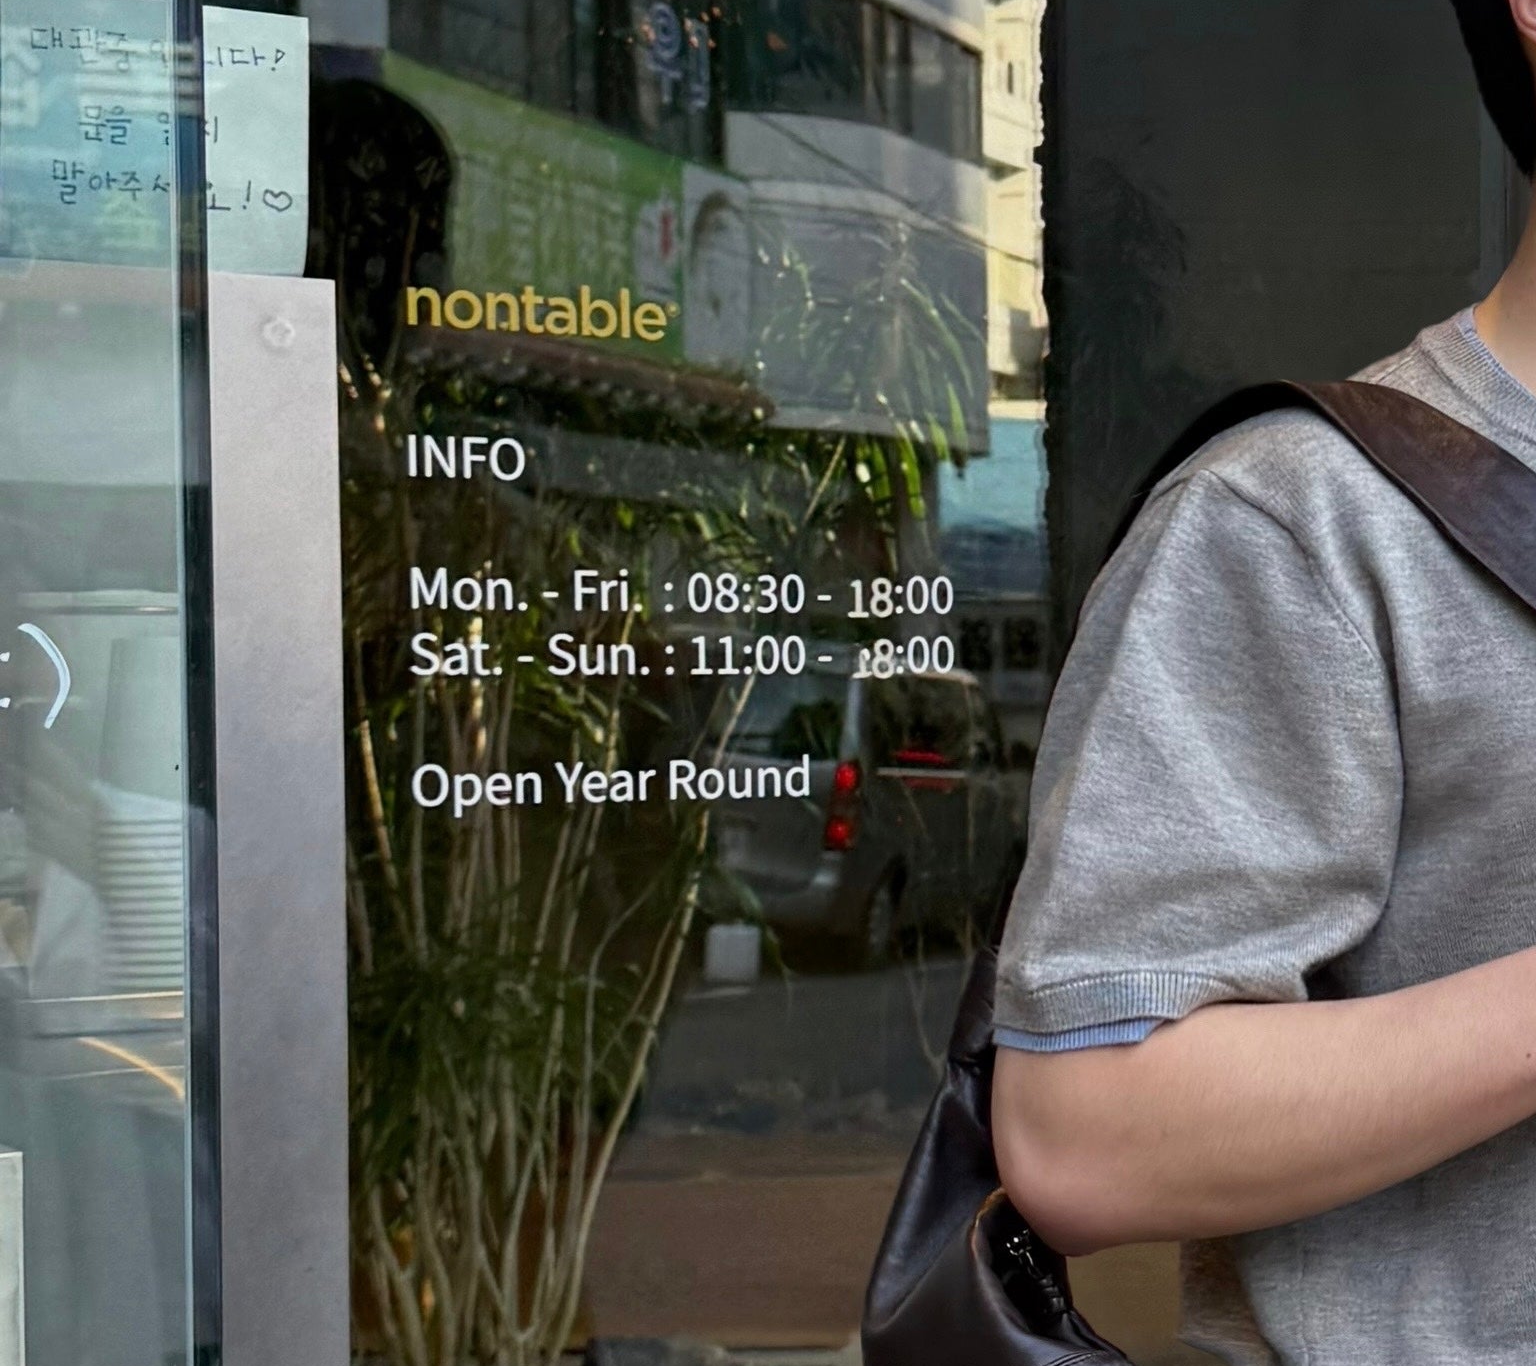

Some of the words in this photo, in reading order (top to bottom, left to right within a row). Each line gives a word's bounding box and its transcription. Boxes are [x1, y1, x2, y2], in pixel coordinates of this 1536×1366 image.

[407, 433, 526, 482] INFO
[410, 566, 529, 612] Mon.
[573, 568, 643, 613] Fri.
[687, 571, 806, 615] 08:30
[847, 575, 955, 619] 18:00
[409, 633, 504, 677] Sat.
[547, 633, 651, 677] Sun.
[690, 635, 807, 676] 11:00
[411, 763, 543, 818] Open
[554, 761, 658, 804] Year
[669, 752, 811, 801] Round
